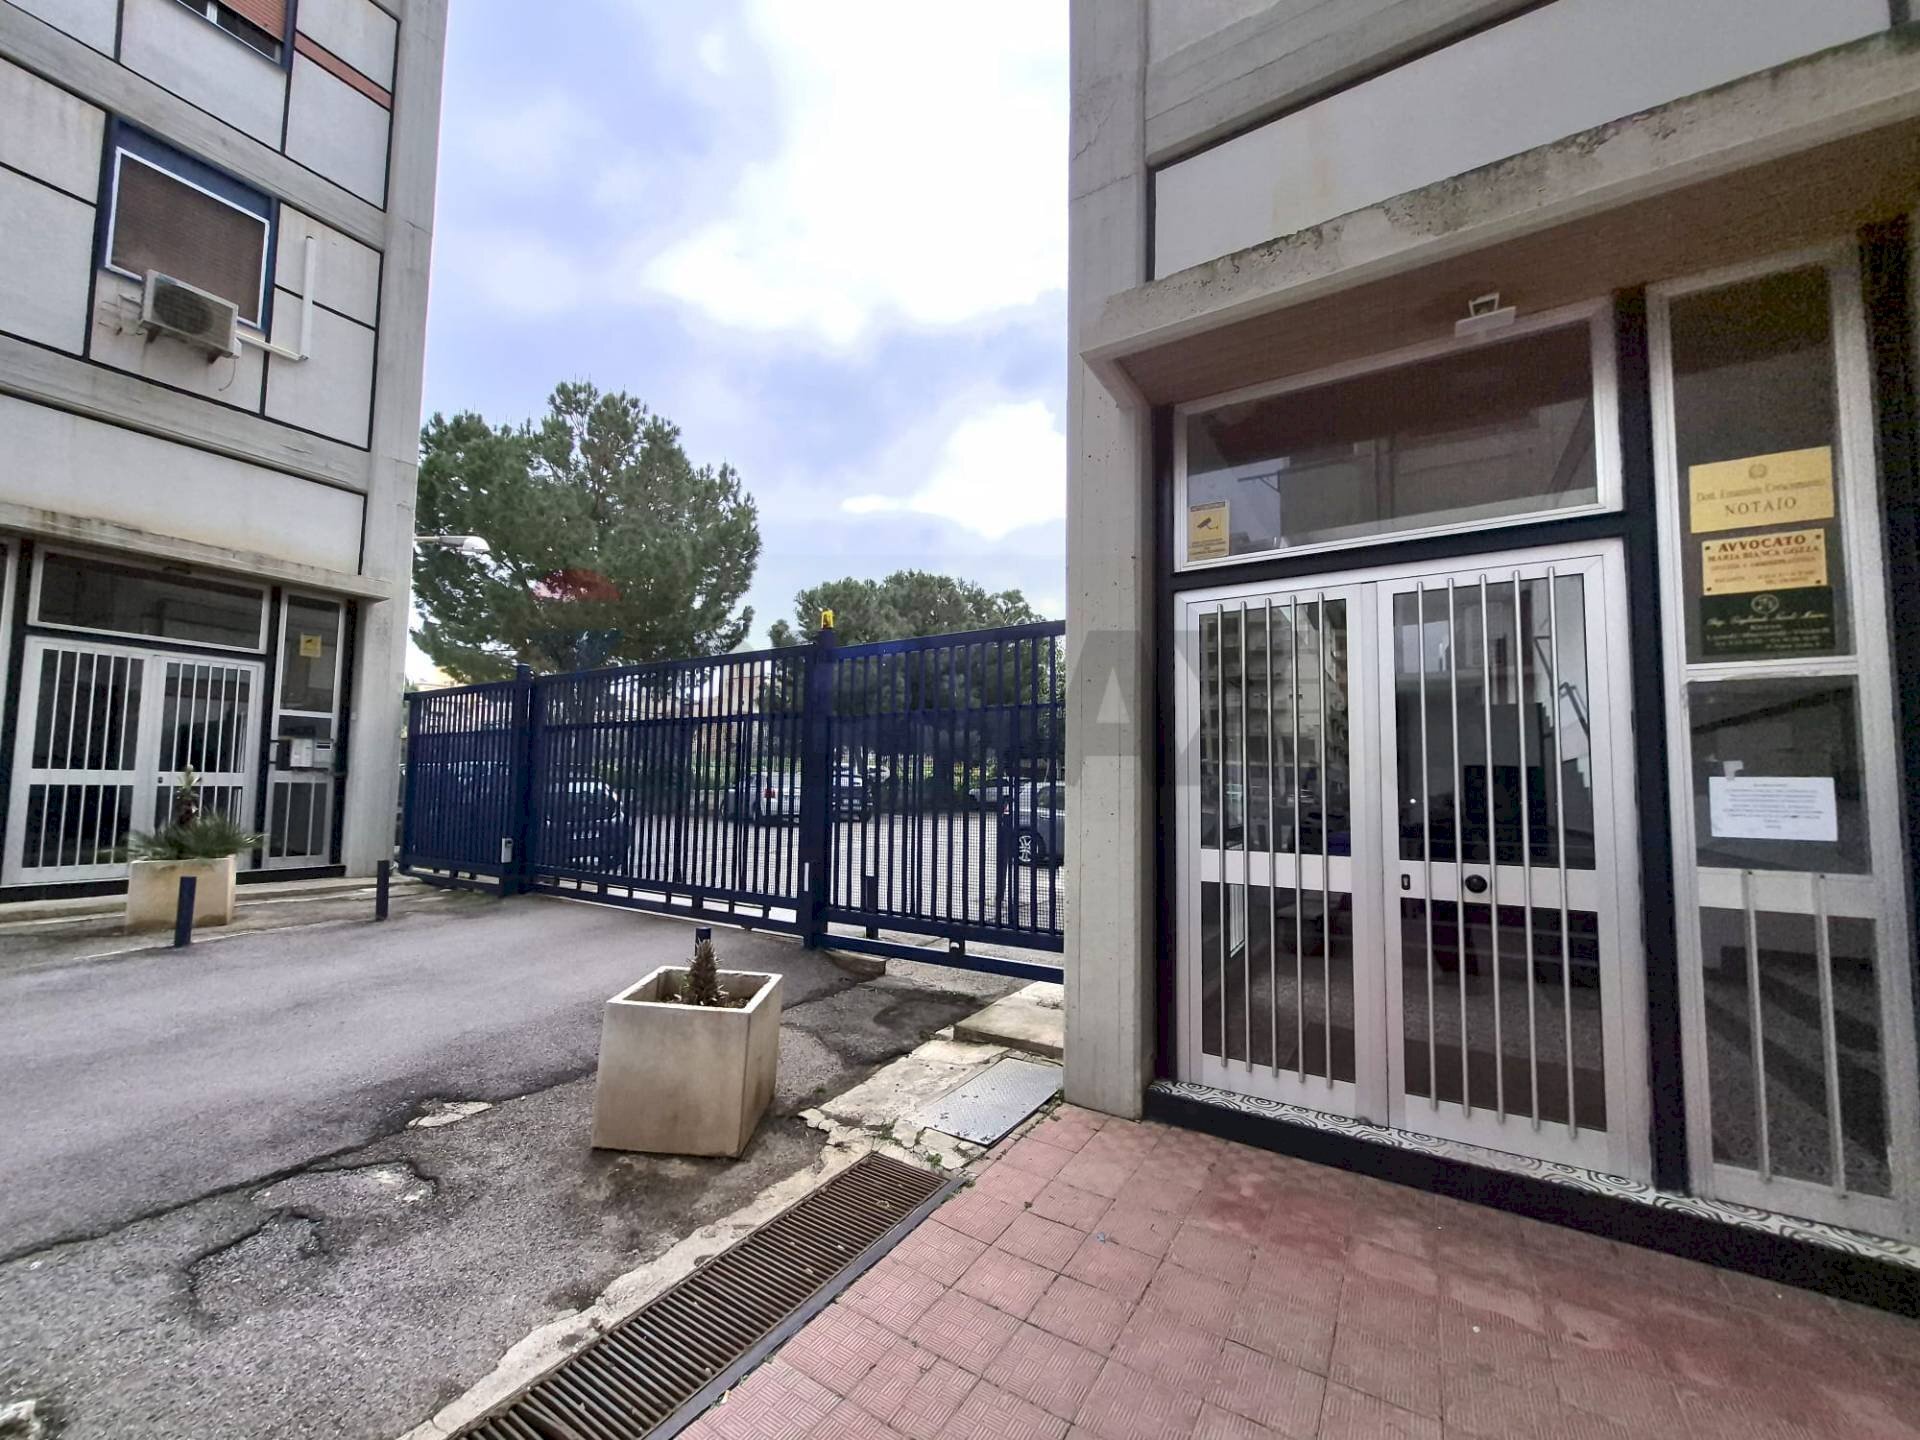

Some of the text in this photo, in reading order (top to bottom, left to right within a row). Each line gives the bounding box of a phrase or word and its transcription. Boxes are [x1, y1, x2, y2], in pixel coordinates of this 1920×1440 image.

[1725, 497, 1797, 516] NOTAIO
[1718, 535, 1806, 552] AVVOCATO
[1708, 553, 1740, 562] MARIA
[1743, 549, 1780, 559] BIANCA
